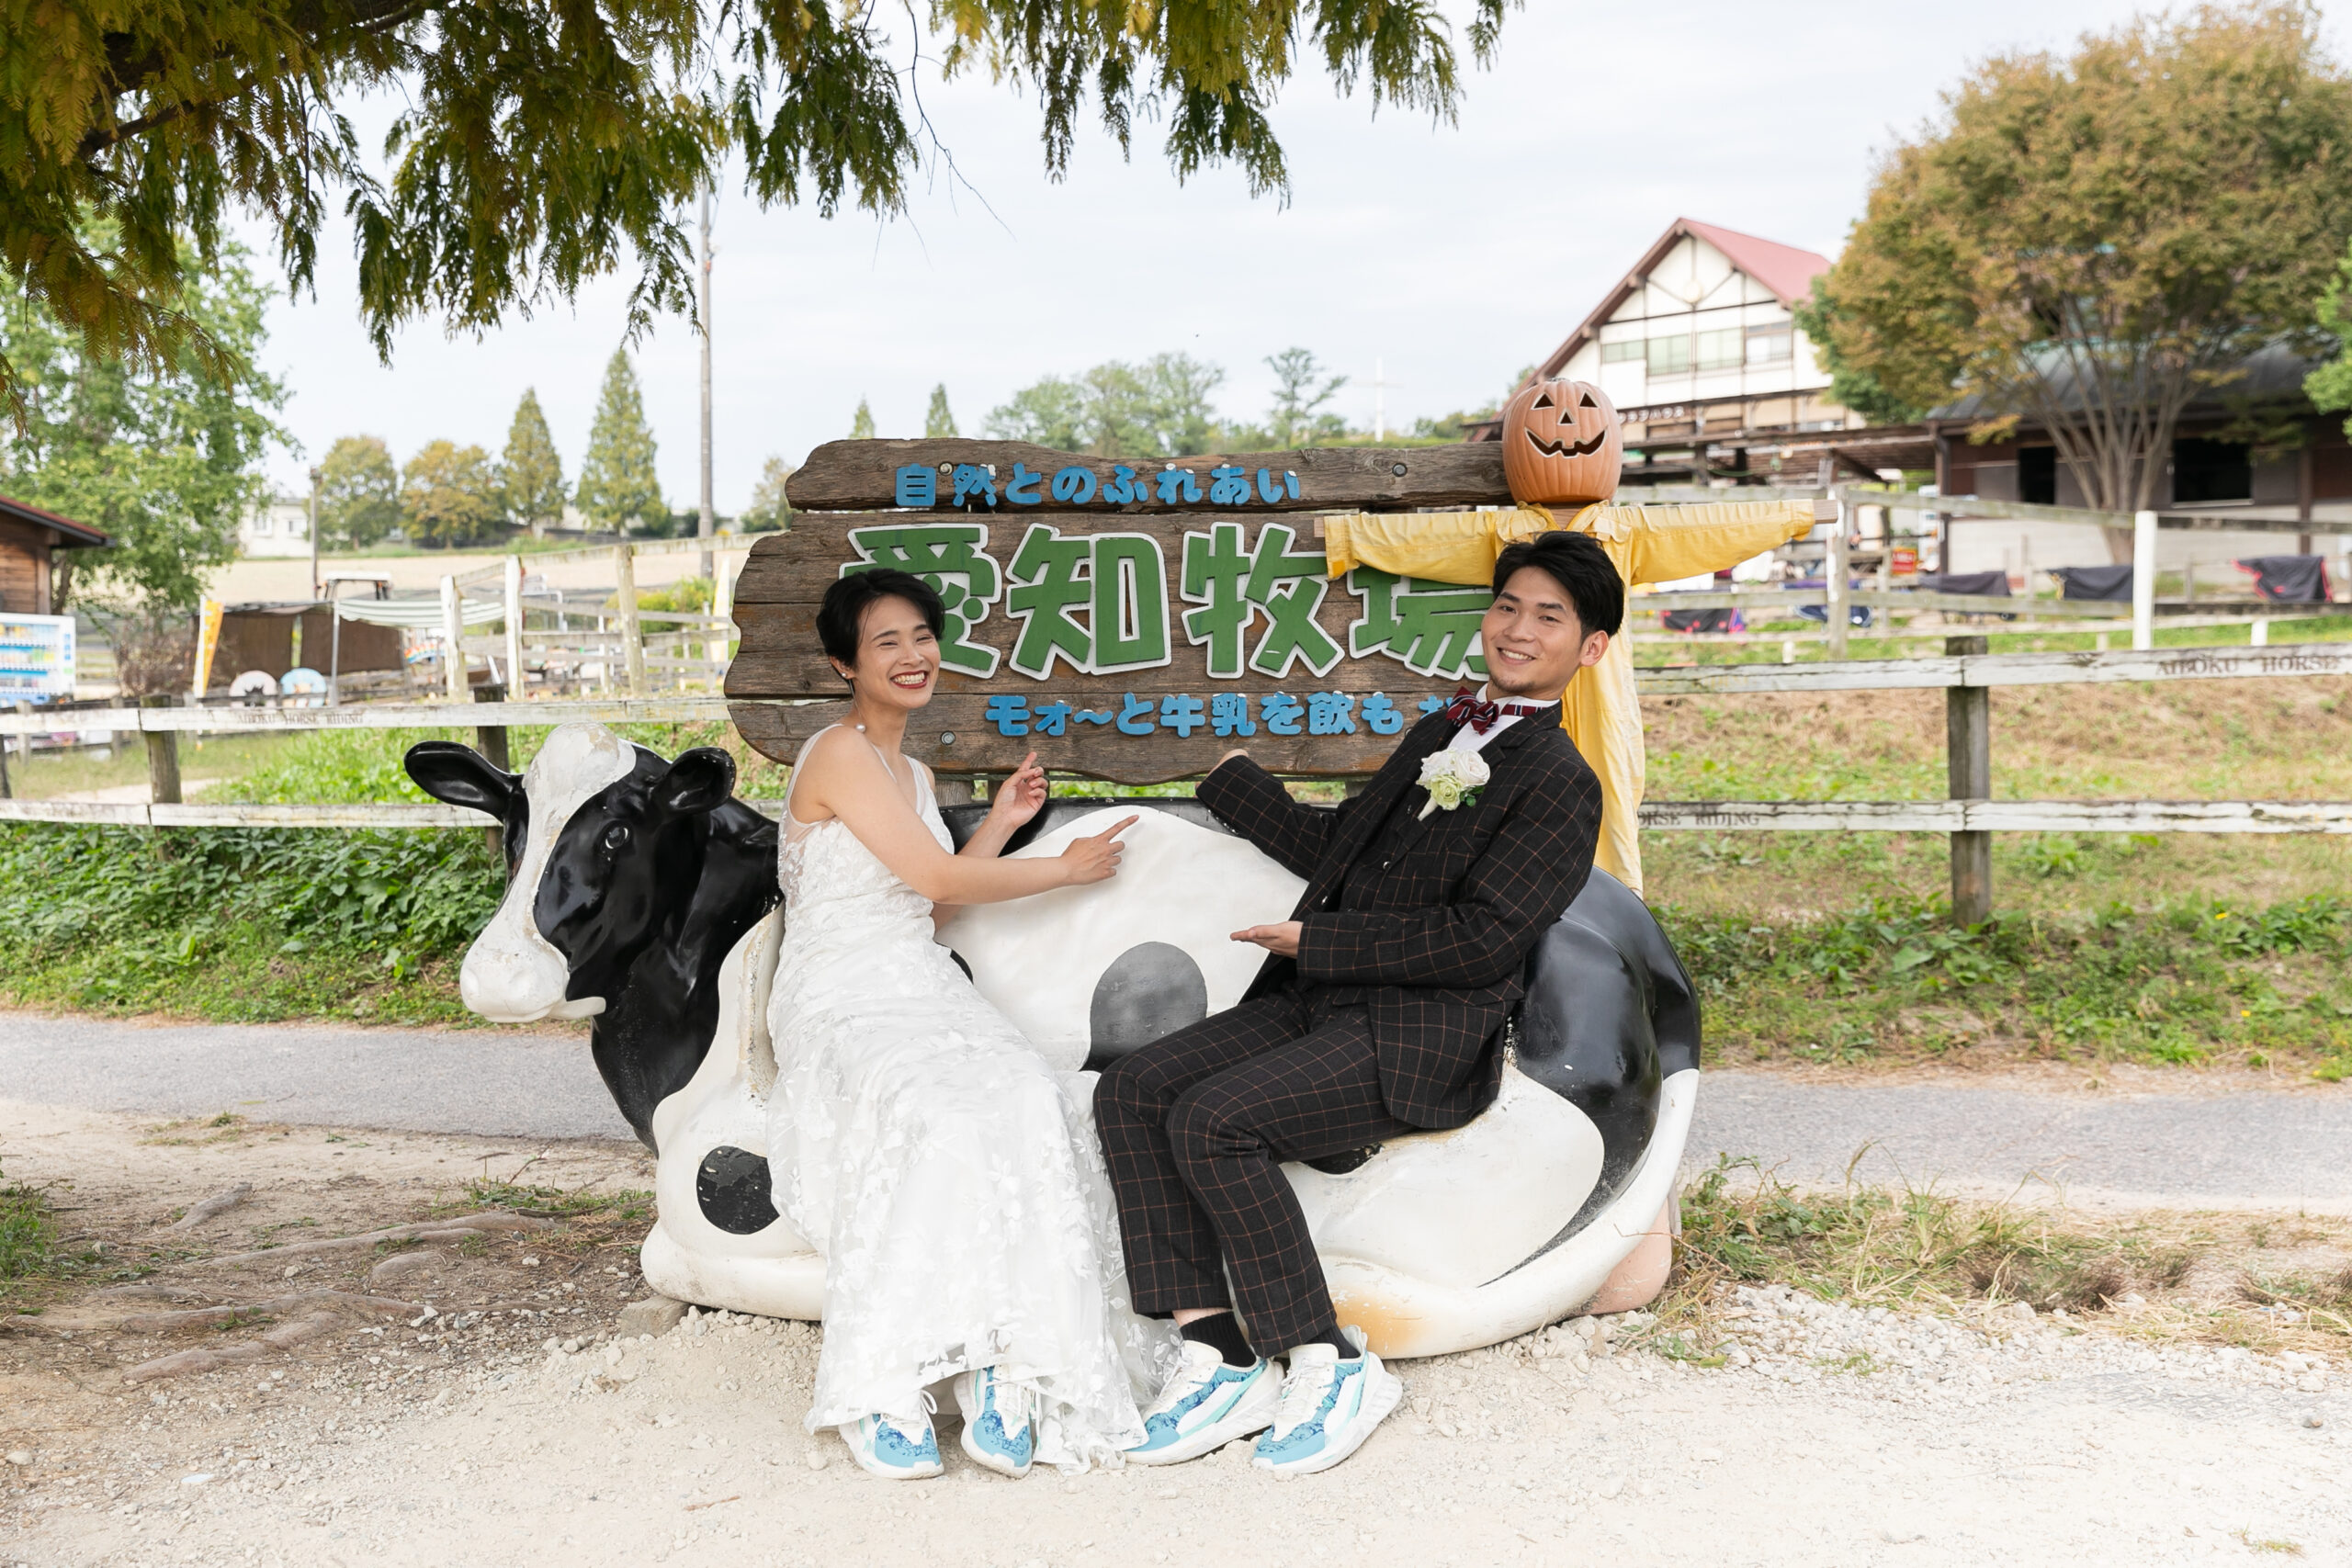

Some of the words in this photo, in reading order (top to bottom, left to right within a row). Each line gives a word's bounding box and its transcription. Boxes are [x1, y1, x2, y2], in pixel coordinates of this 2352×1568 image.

[895, 462, 1301, 507] 自然とのふれあい
[2156, 656, 2239, 675] AIBOKU
[2261, 655, 2342, 672] HORSE
[283, 713, 319, 724] HORSE
[327, 712, 364, 724] RIDING
[1637, 811, 1681, 826] ORSE
[1695, 811, 1760, 826] RIDING
